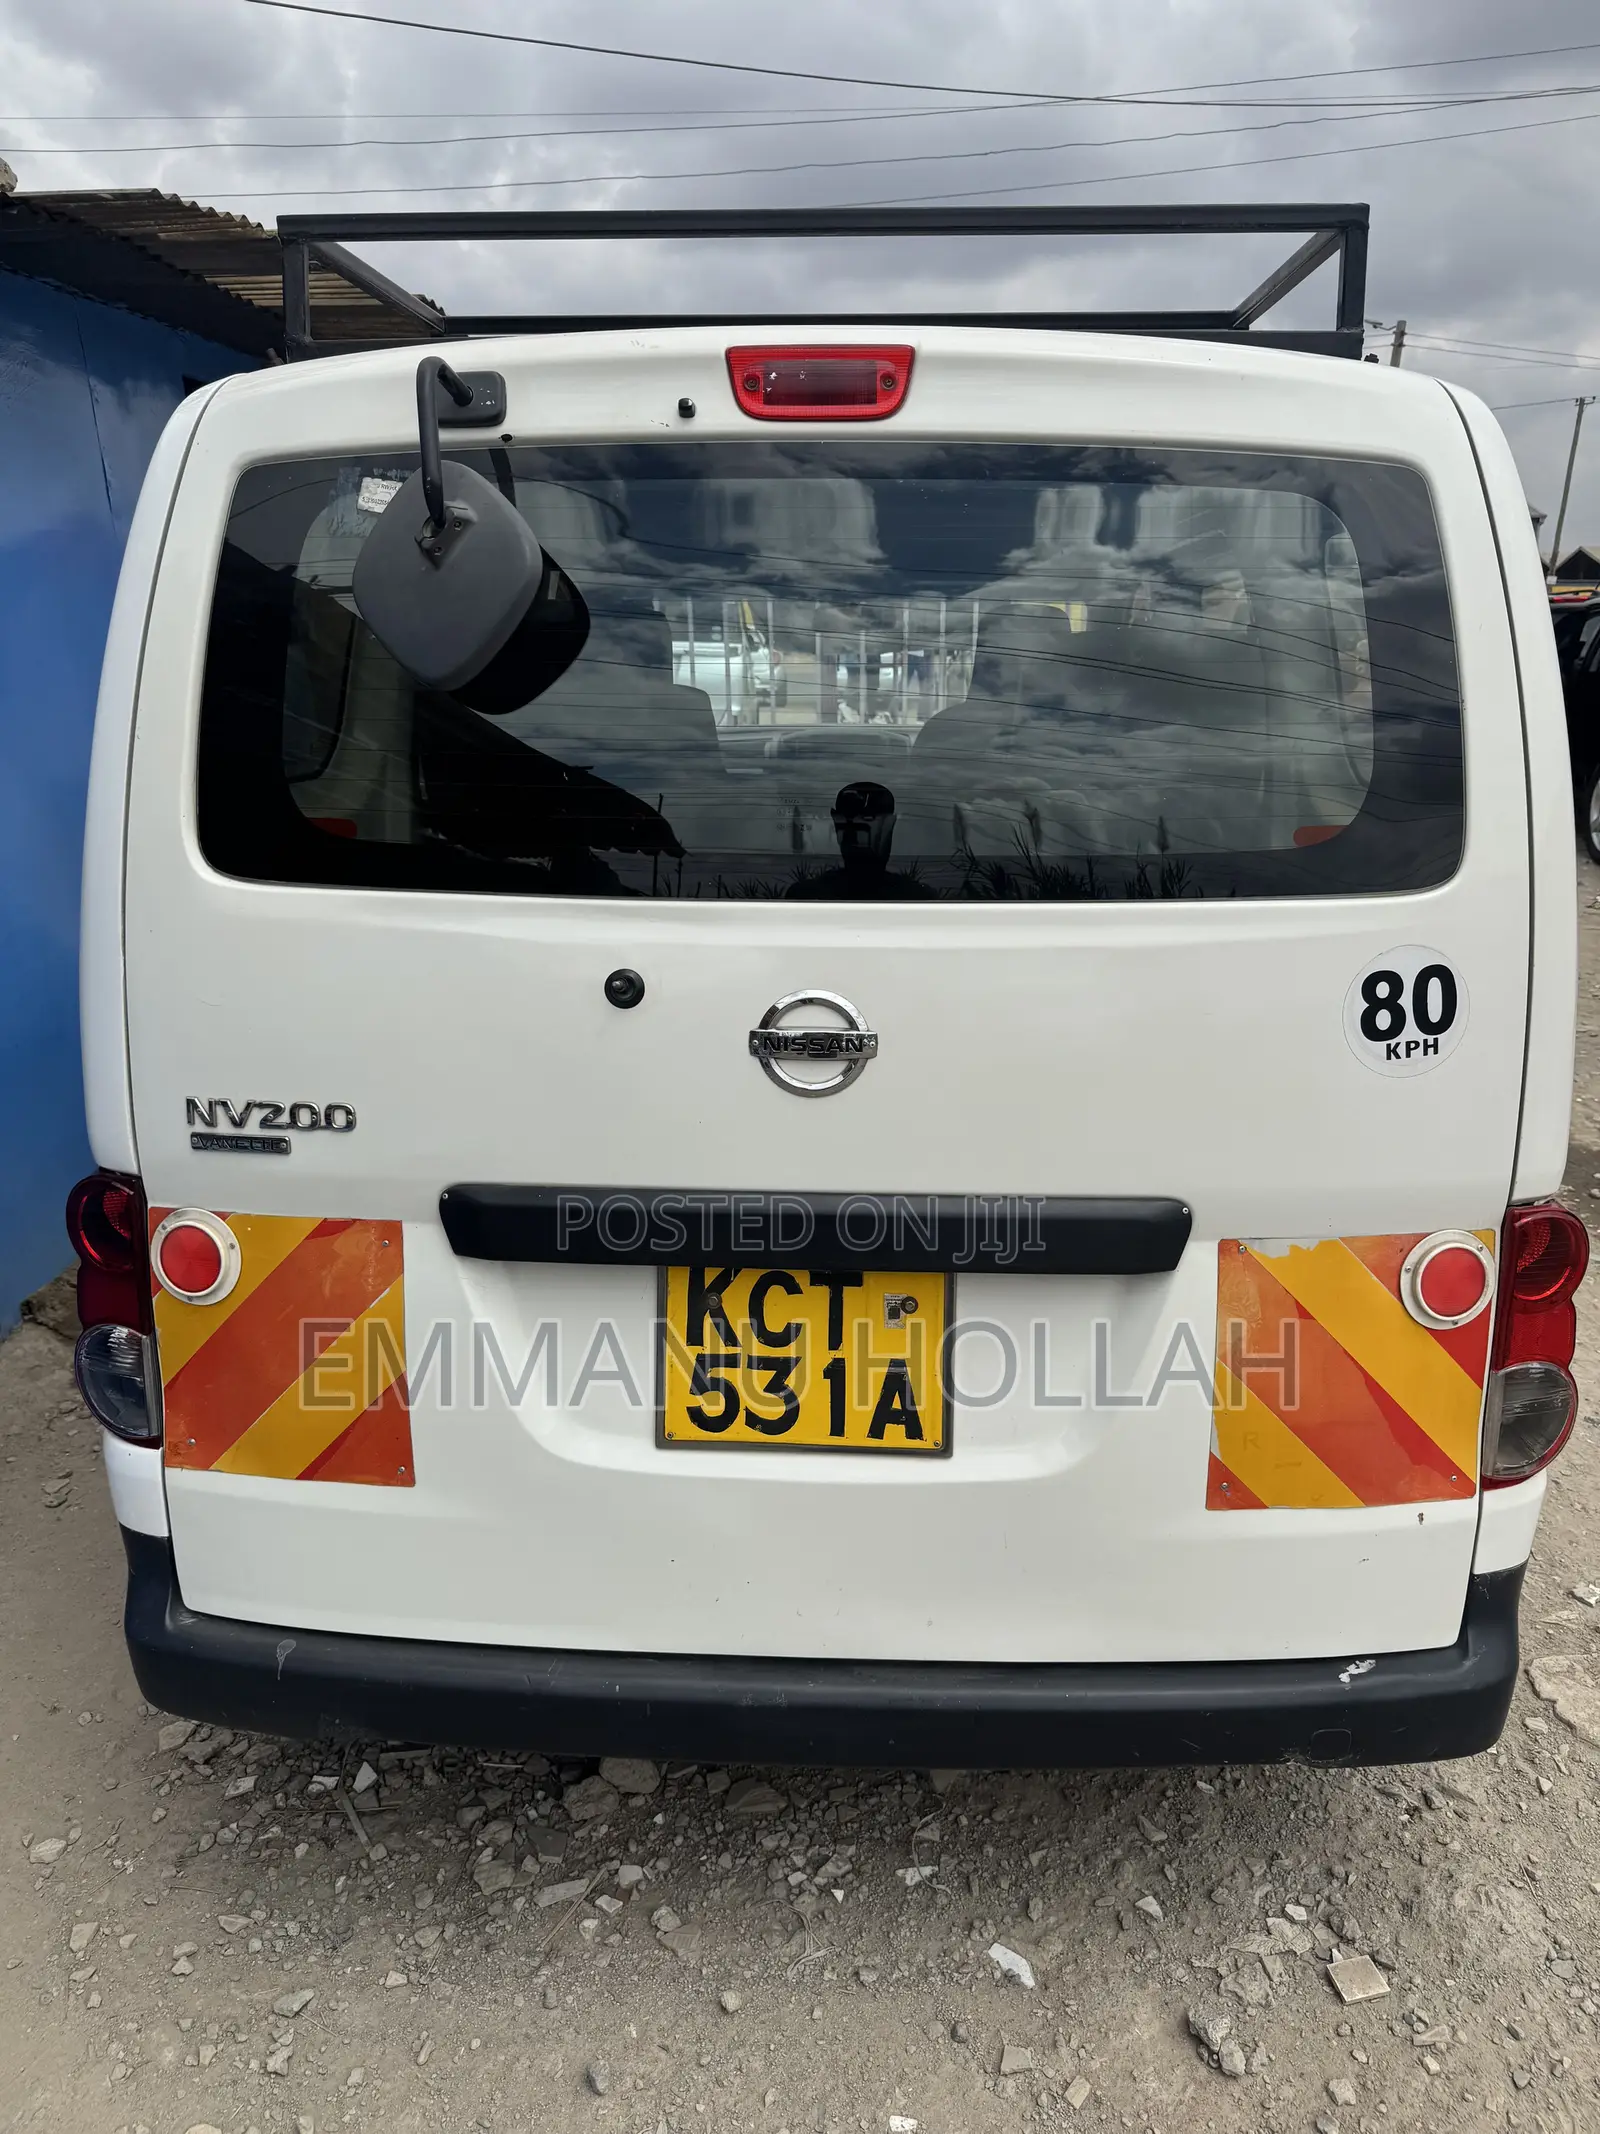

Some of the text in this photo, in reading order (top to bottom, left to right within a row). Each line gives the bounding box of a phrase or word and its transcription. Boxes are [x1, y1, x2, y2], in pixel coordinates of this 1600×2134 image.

[1360, 963, 1458, 1042] 80
[763, 1036, 864, 1053] NISSAN
[1385, 1037, 1439, 1061] KPH
[186, 1097, 356, 1132] NV200
[685, 1266, 863, 1351] KCT
[685, 1353, 927, 1440] 531A
